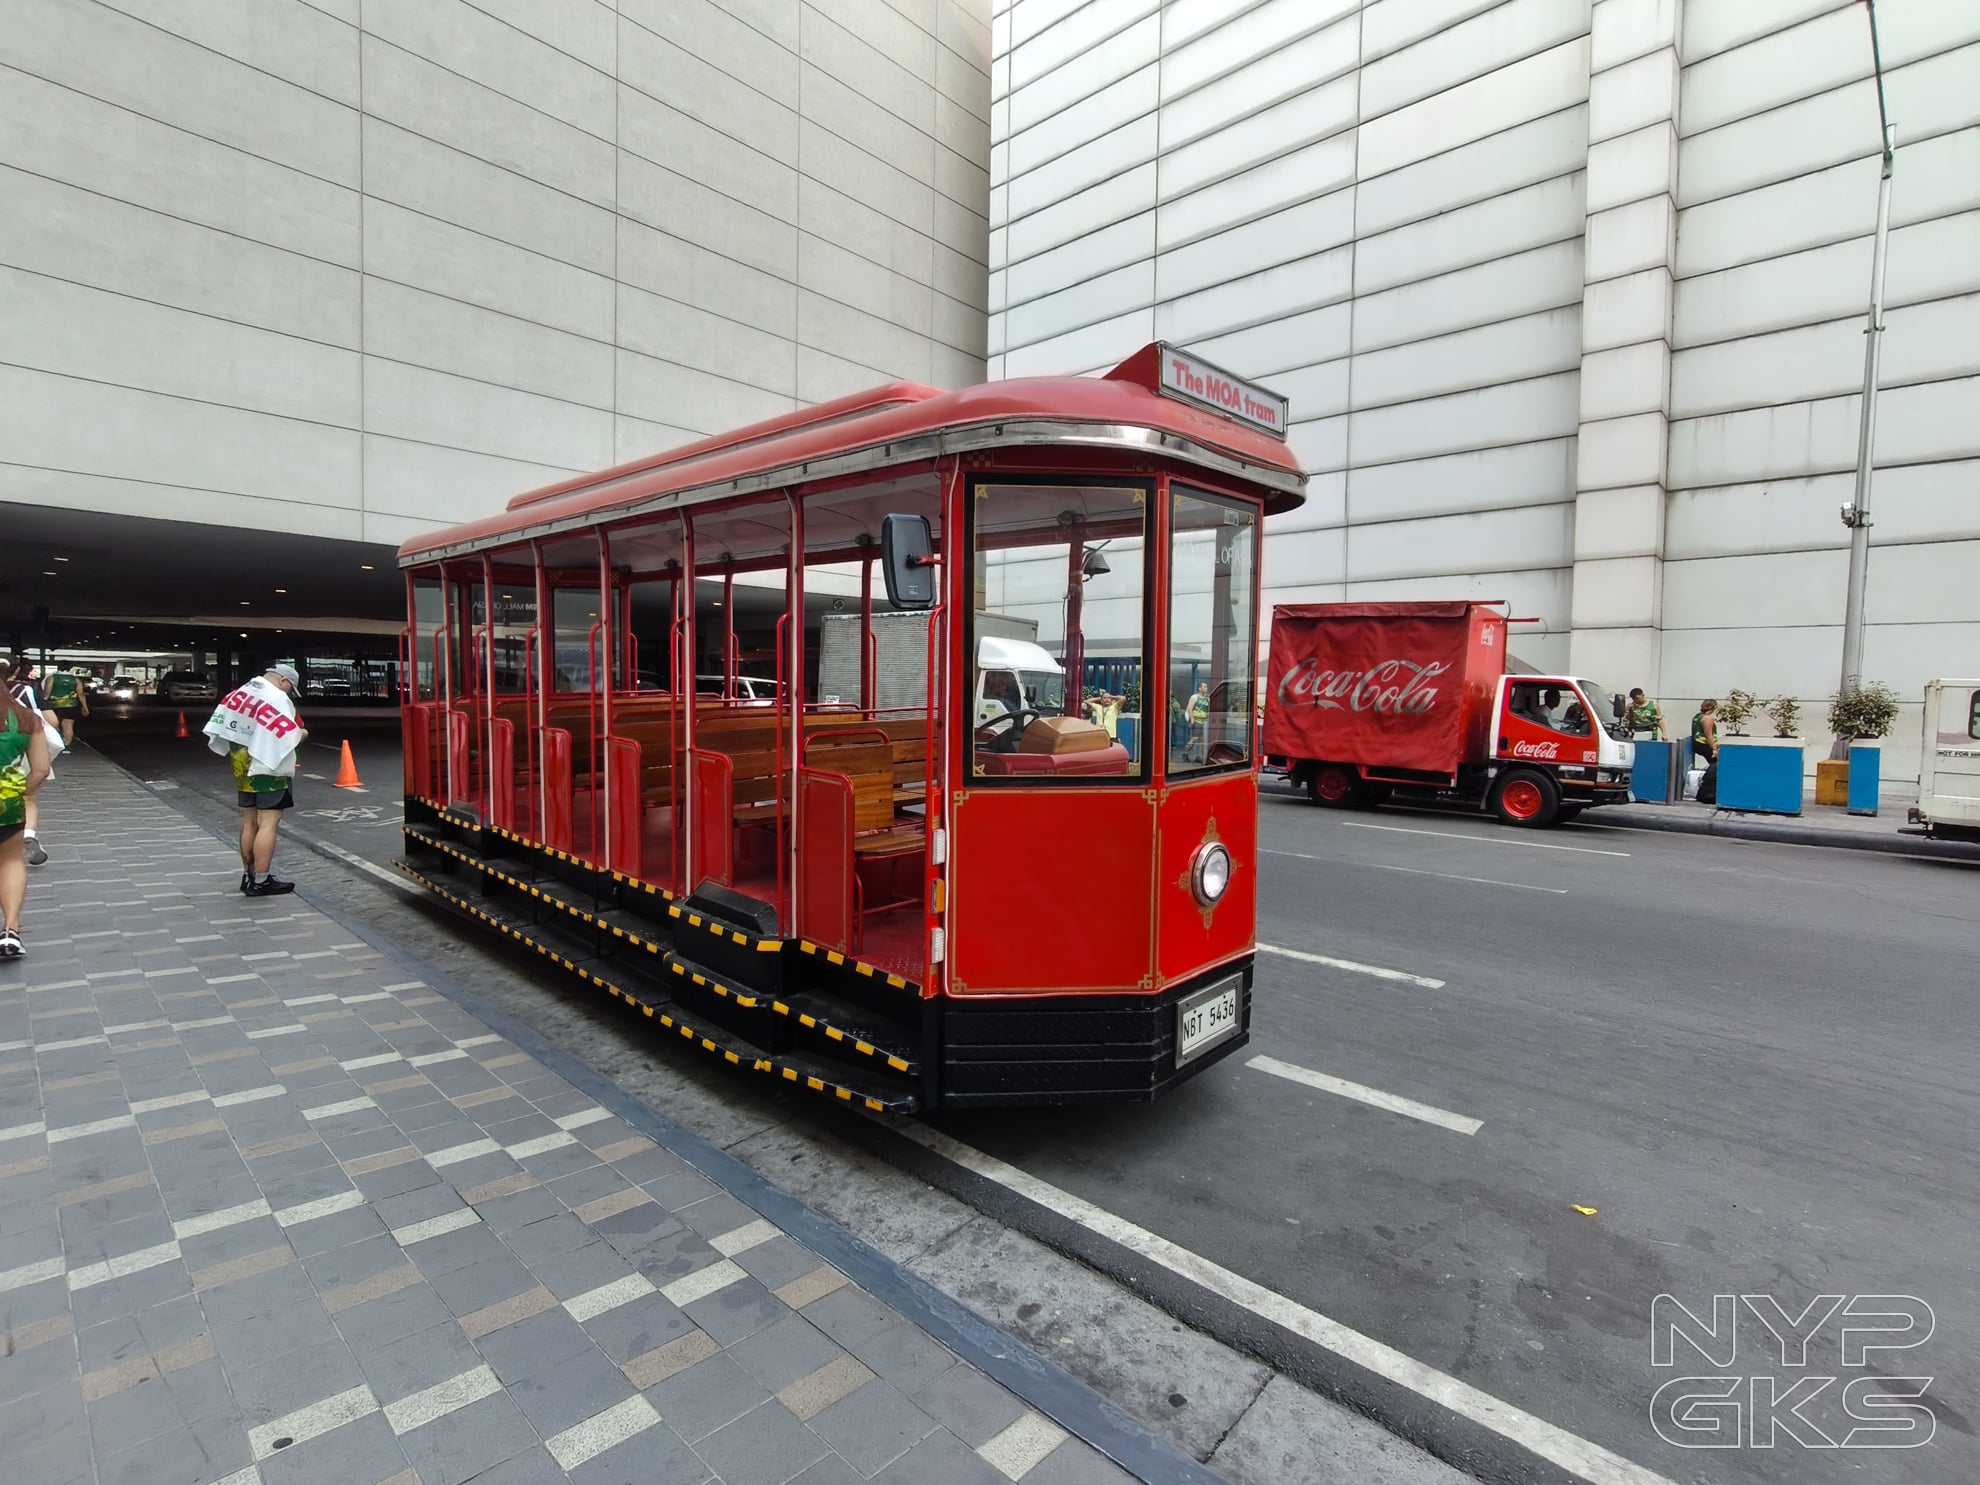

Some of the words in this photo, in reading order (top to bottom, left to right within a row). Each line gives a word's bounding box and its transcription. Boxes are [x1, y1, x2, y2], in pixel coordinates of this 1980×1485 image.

[1172, 360, 1203, 395] The
[1206, 374, 1241, 411] MOA
[1244, 394, 1275, 424] tram
[1183, 1013, 1203, 1042] NBT
[1210, 997, 1234, 1027] 5436
